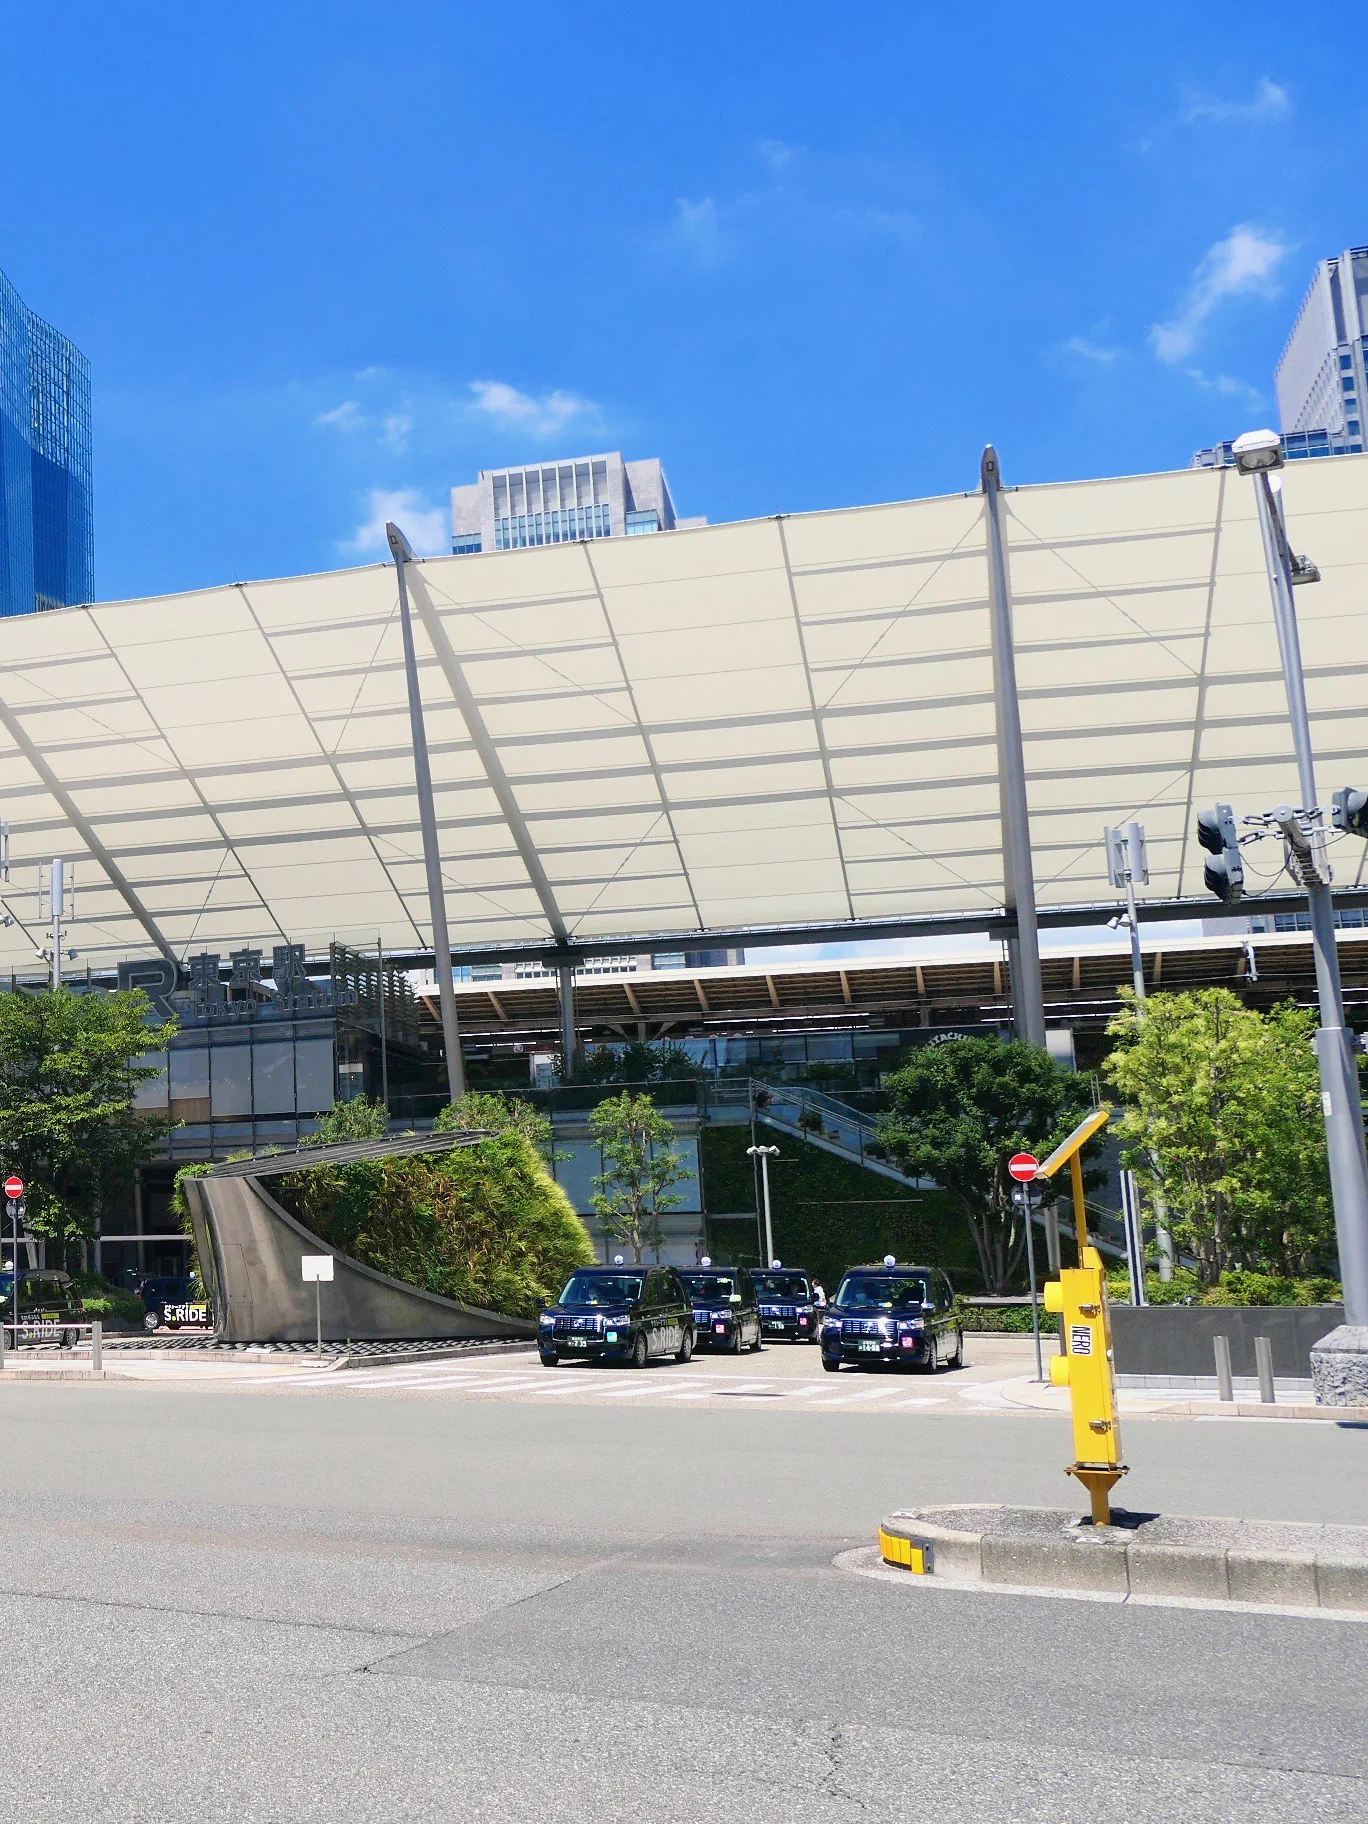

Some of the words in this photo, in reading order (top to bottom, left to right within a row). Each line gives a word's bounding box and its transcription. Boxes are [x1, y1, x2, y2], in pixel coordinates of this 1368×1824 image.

[188, 943, 307, 989] 東京駅
[193, 997, 257, 1019] Tokyo
[271, 986, 358, 1011] Station
[164, 1308, 207, 1322] S.RIDE
[651, 1325, 680, 1350] S.RIDE
[1072, 1326, 1090, 1354] NERO
